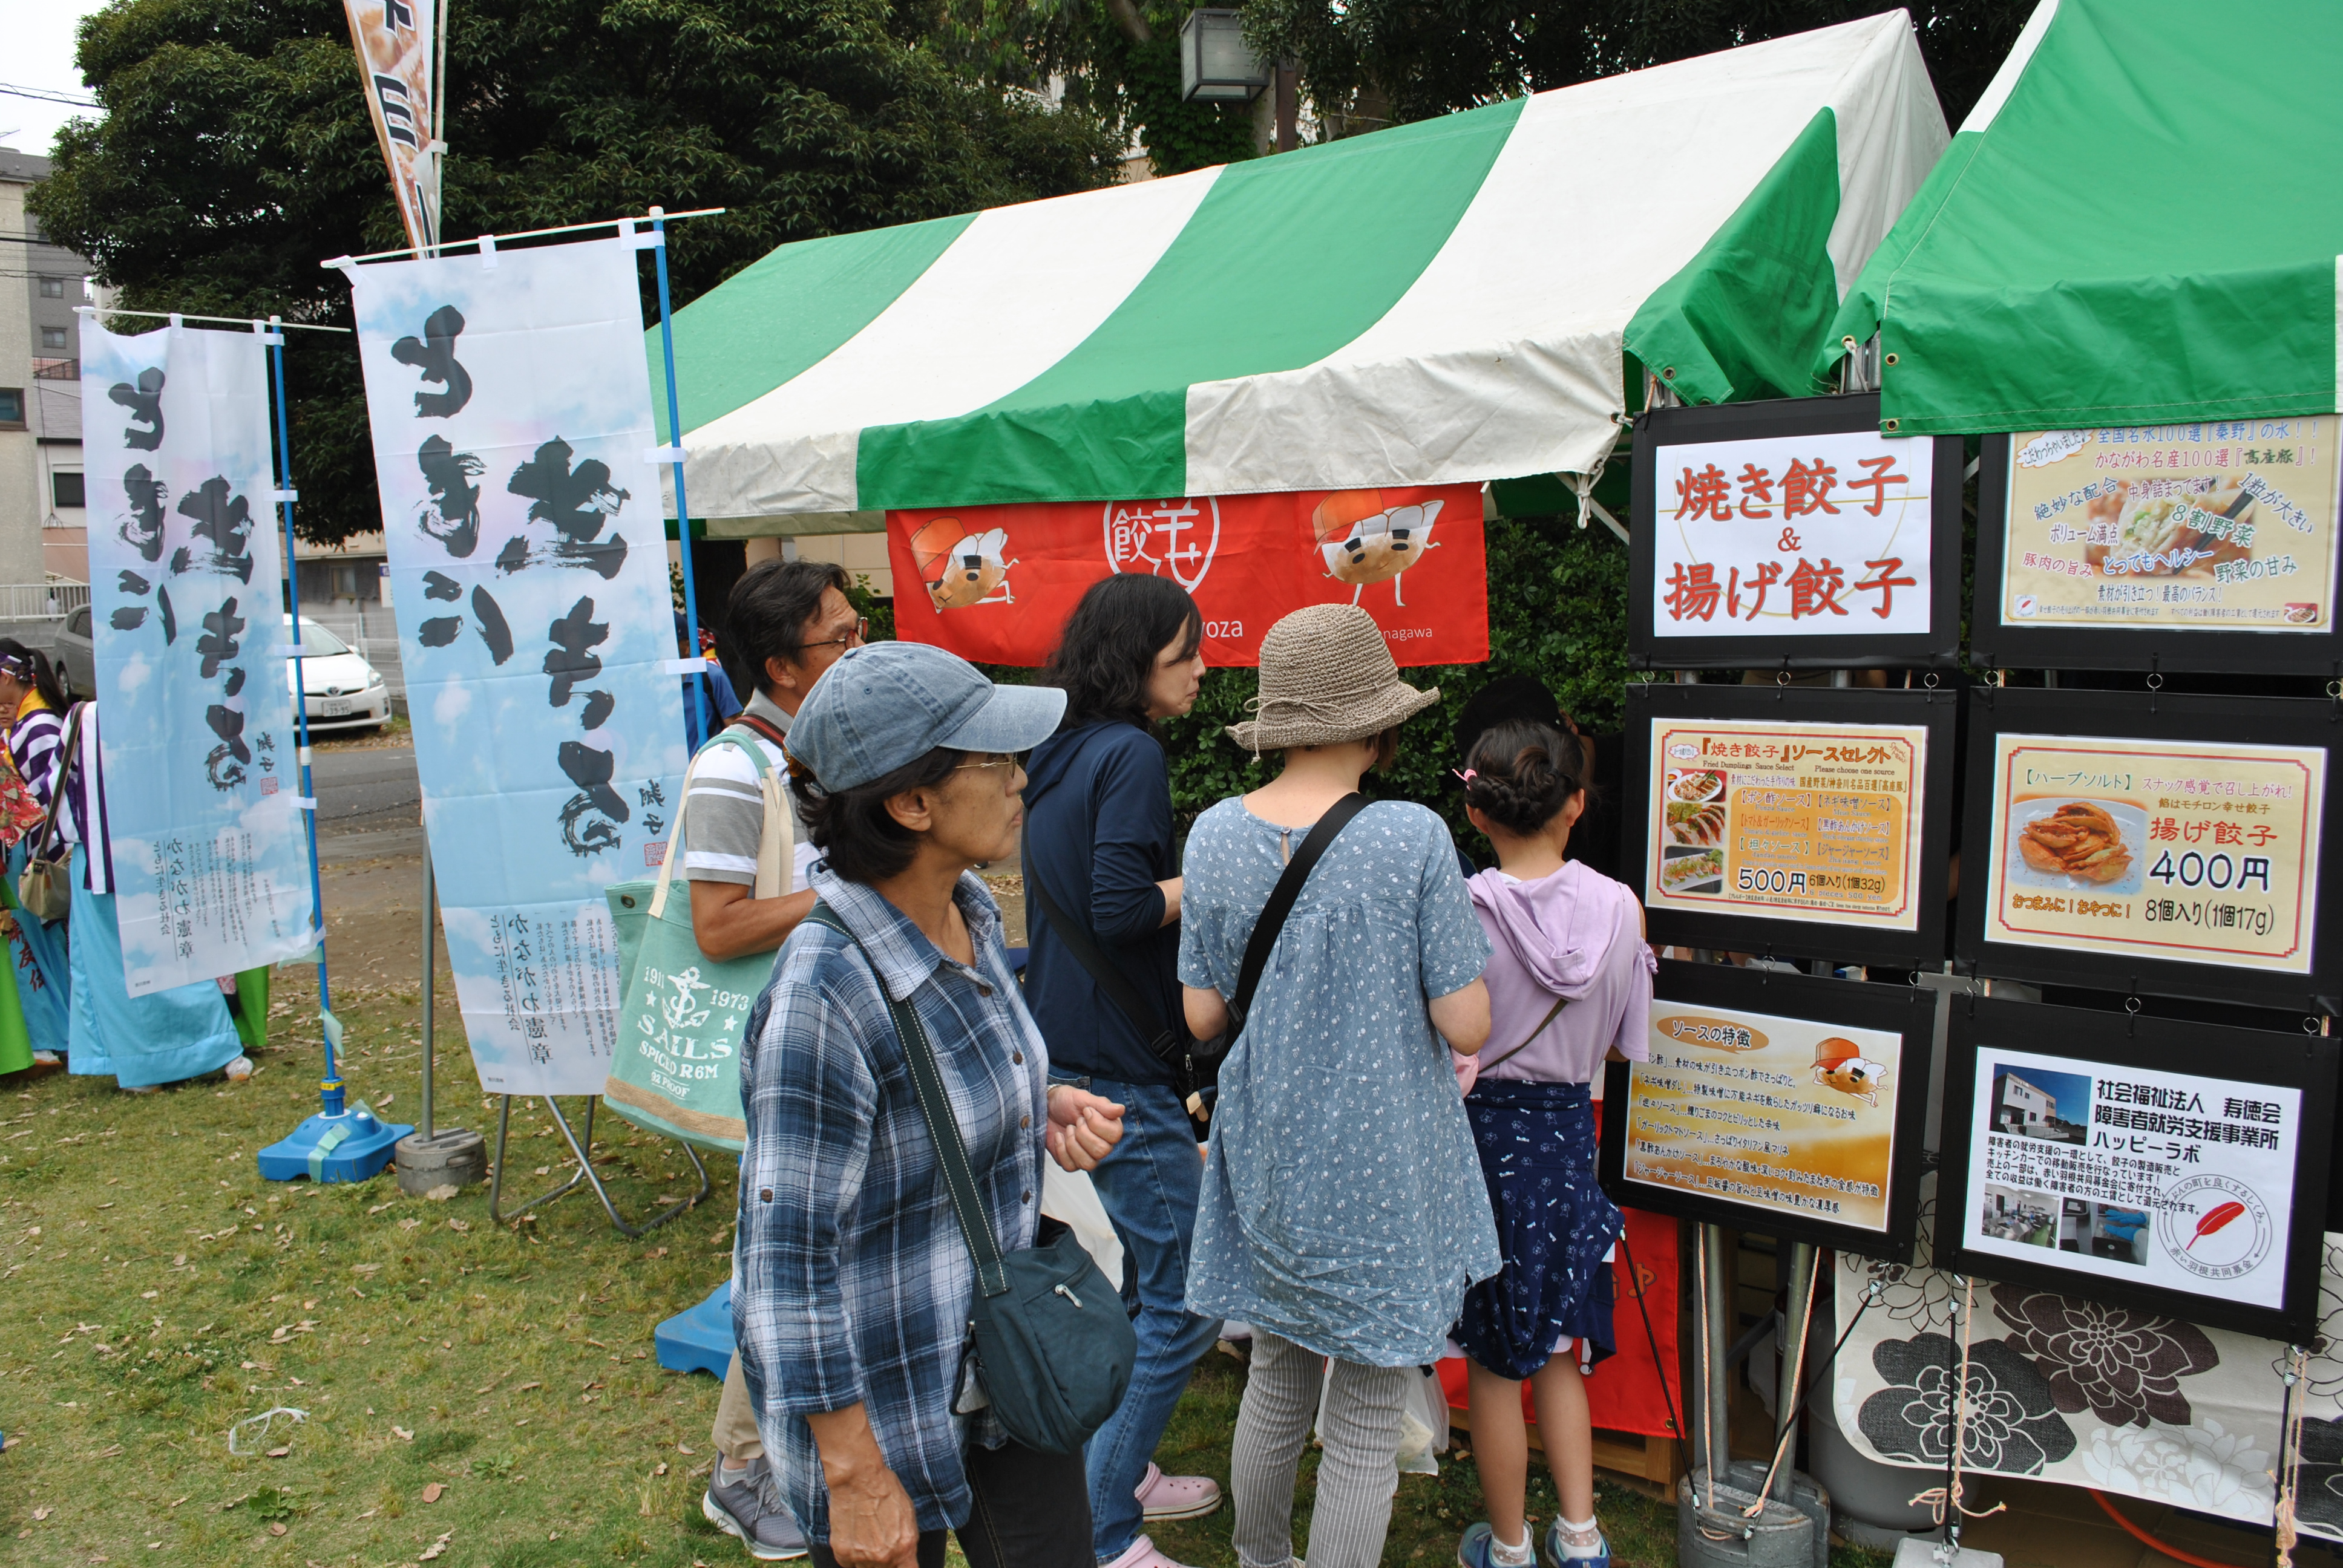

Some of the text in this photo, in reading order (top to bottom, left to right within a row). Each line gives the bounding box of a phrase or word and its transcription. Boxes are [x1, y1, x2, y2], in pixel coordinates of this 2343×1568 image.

[1674, 455, 1909, 521] 焼き餃子
[2033, 476, 2119, 522] 絶妙な配合
[2128, 475, 2222, 501] 中身詰まってます！
[2236, 472, 2314, 535] 1粒が大きい
[2049, 523, 2119, 545] ボリューム満点
[2172, 503, 2257, 547] 8割野菜
[1777, 527, 1802, 552] &
[2022, 551, 2094, 579] 豚肉の旨み
[2103, 547, 2215, 576] とってもヘルシー
[2214, 555, 2298, 584] 野菜の甘み
[1663, 557, 1917, 622] 揚げ餃子
[2097, 583, 2223, 603] 素材が引き立つ！最高のバランス！
[1202, 620, 1243, 638] oza
[1701, 737, 1892, 764] 『焼き餃子』ソースセレクト
[1720, 760, 1752, 769] Dumplings
[1775, 762, 1794, 771] Select
[1814, 765, 1833, 773] Please
[2025, 768, 2132, 791] 【ハーブソルト】
[1742, 790, 1810, 808] 【ポン酢ソース】
[2141, 777, 2293, 799] スナック感覚で召し上がれ！
[1818, 794, 1890, 812] 【ネギ味噌ソース】
[2149, 816, 2278, 847] 揚げ餃子
[1739, 869, 1805, 893] 500円
[1809, 874, 1886, 893] 6個入り(1個32g)
[2149, 850, 2269, 892] 400円
[2146, 898, 2274, 935] 8個入り(1個17g)
[710, 989, 749, 1011] 1973
[637, 1014, 733, 1060] SAILS
[1673, 1021, 1752, 1048] ソースの特徴
[639, 1040, 677, 1075] SPICED
[662, 1078, 690, 1097] PROOF
[2097, 1079, 2282, 1125] 社会福祉法人 寿徳会
[2094, 1104, 2279, 1152] 障害者就労支援事業所
[1987, 1136, 2181, 1177] 障害者の就労支援の一環として、餃子の製造販売と
[2094, 1130, 2201, 1164] ハッピーラボ
[2169, 1246, 2254, 1278] 赤い羽根共同募金
